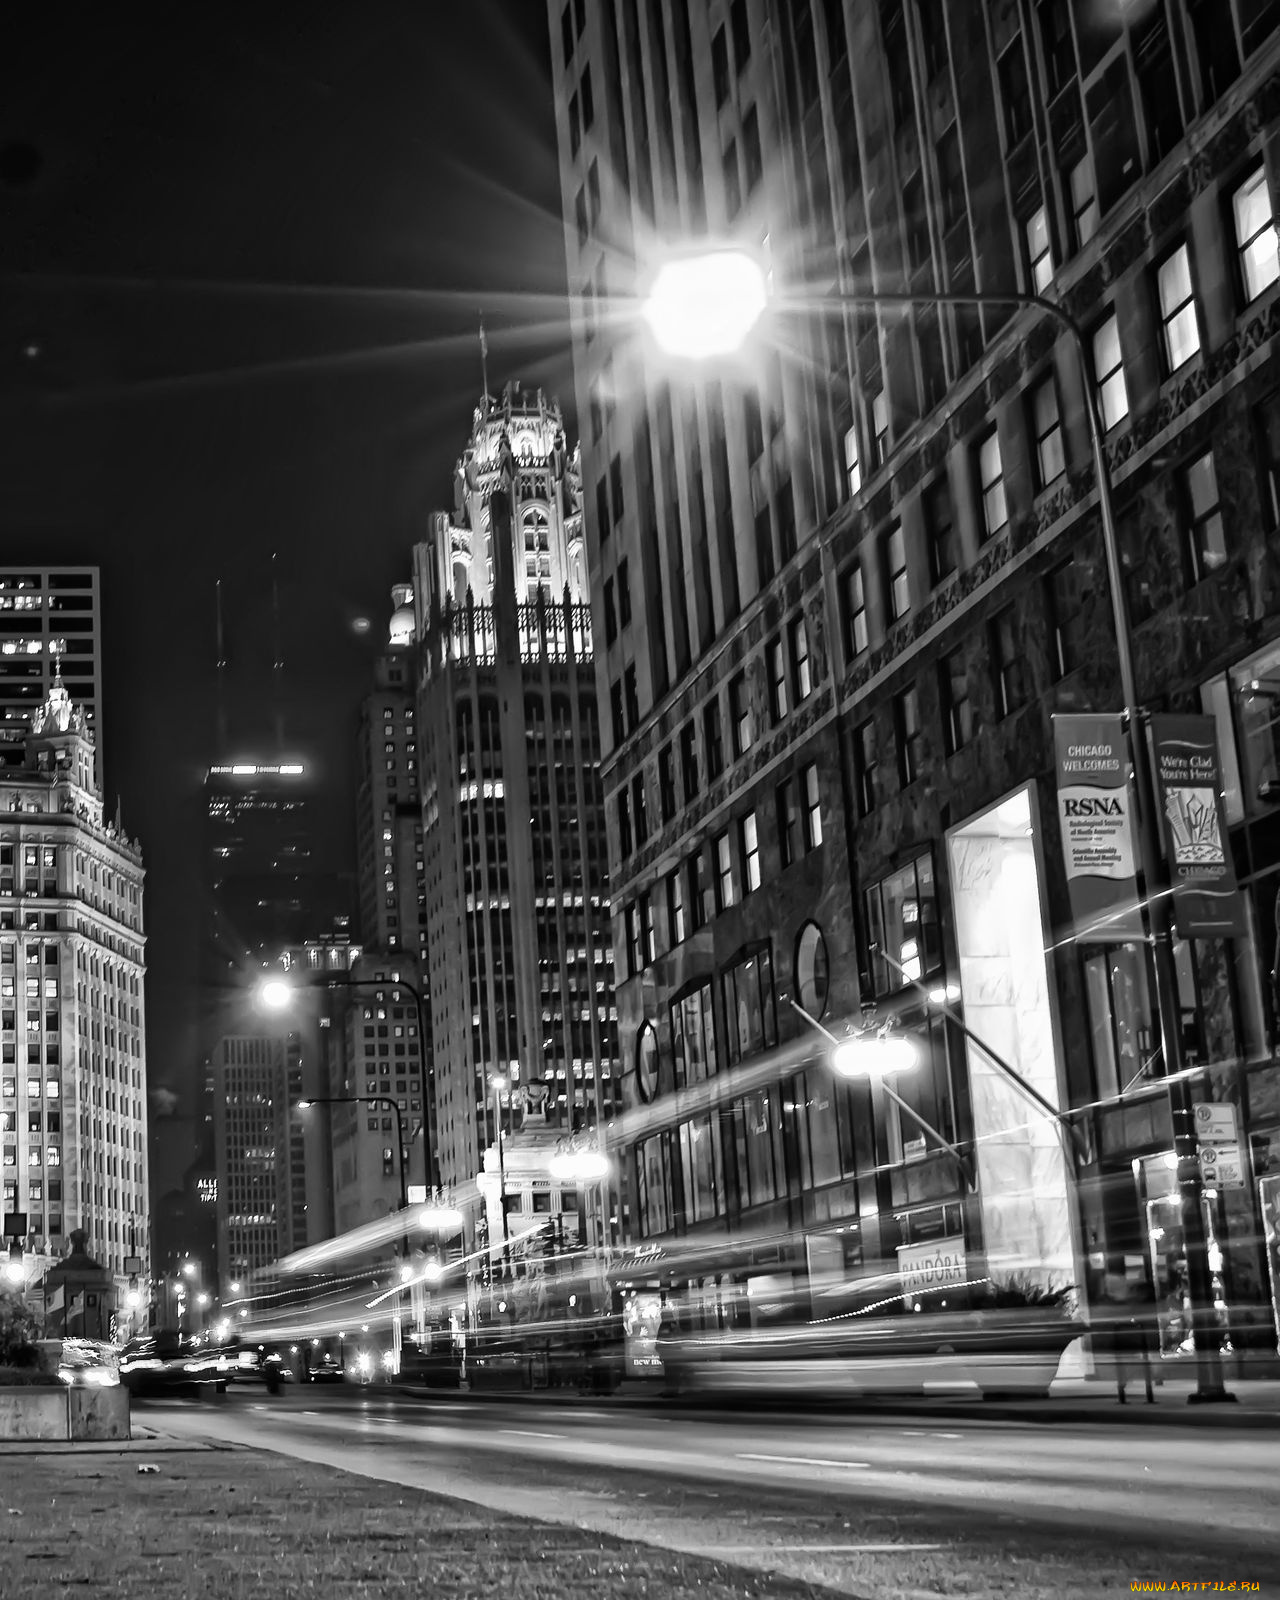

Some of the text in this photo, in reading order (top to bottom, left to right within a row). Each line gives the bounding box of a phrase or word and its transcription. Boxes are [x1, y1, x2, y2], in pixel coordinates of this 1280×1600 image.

[1068, 744, 1113, 757] CHICAGO
[1062, 759, 1120, 772] WELCOMES
[1189, 755, 1213, 768] Glad
[1063, 797, 1125, 817] RSNA
[902, 1251, 962, 1287] PANDORA
